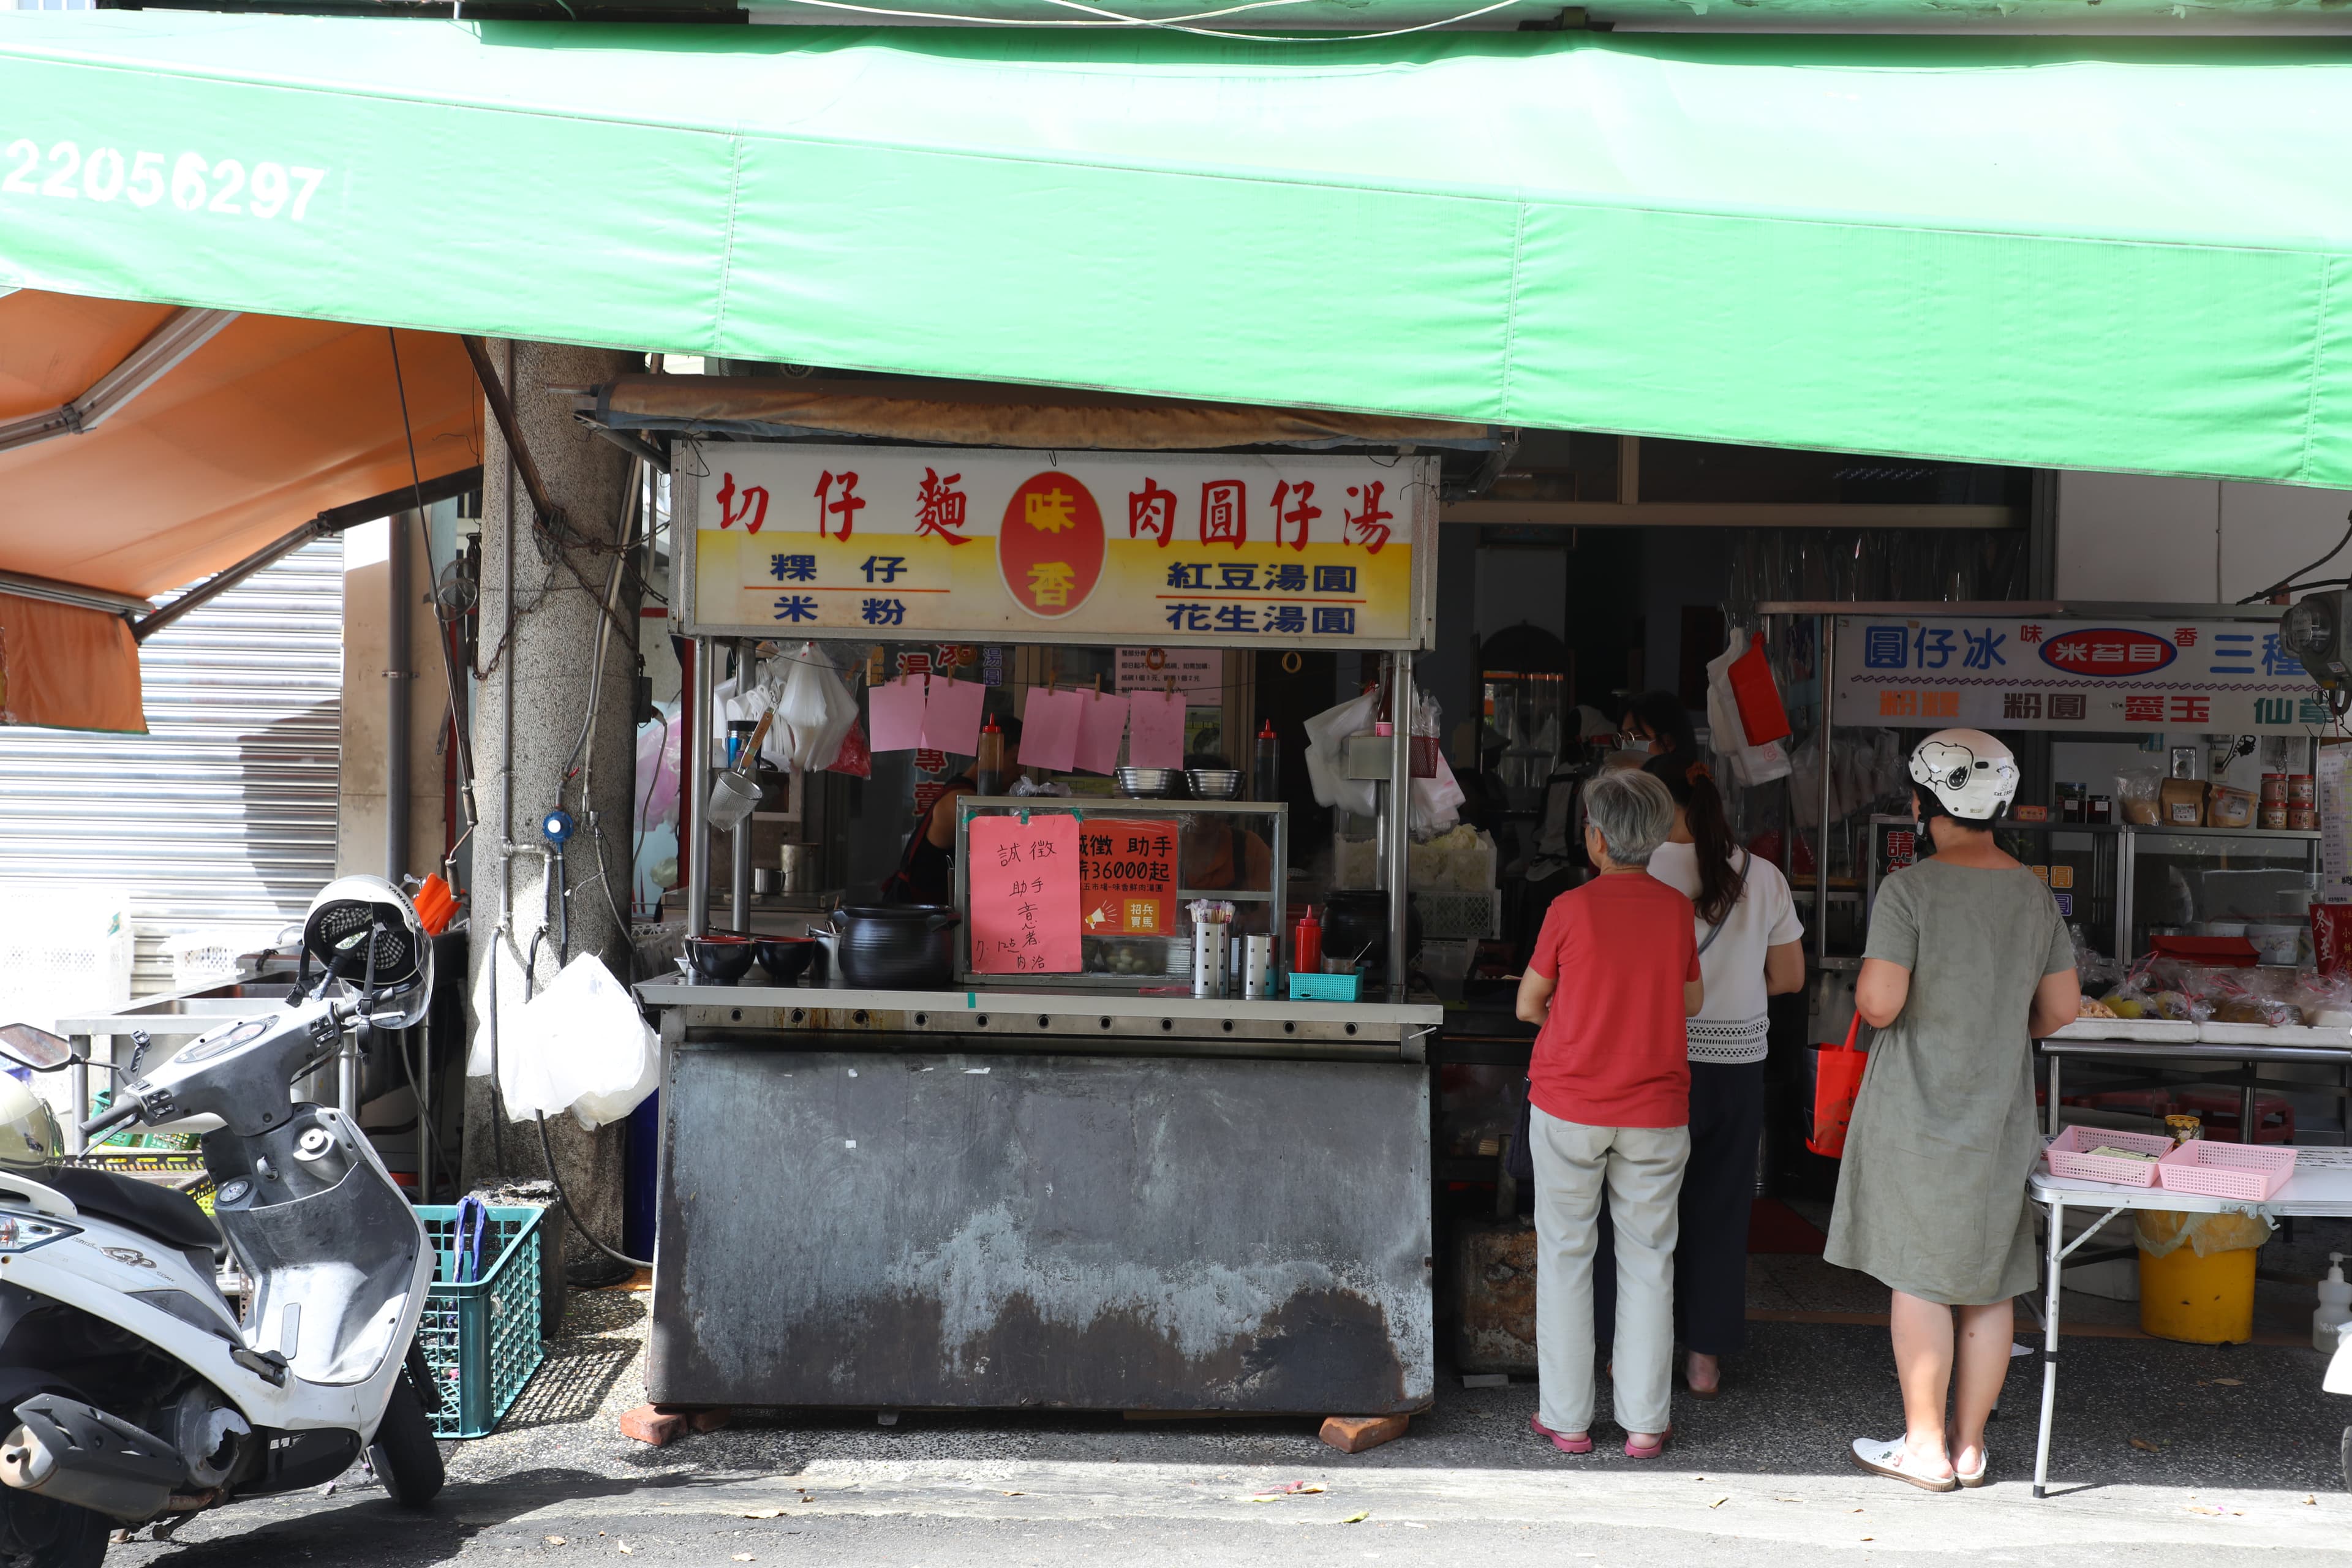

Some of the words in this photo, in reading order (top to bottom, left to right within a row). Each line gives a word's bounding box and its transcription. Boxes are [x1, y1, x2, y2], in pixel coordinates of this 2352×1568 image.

[3, 138, 327, 221] 22056297
[715, 467, 973, 546] 切仔麵
[1128, 477, 1393, 554] 肉圓仔湯
[1024, 488, 1076, 607] 味香
[770, 554, 907, 584] 粿仔
[1166, 562, 1357, 593] 紅豆湯圓
[774, 595, 907, 625] 米粉
[1166, 604, 1355, 635] 花生湯圓
[1864, 625, 2007, 669] 圓仔冰
[2020, 624, 2043, 644] 味
[2174, 627, 2199, 647] 香
[2055, 643, 2162, 663] 米苔目
[2003, 692, 2087, 719] 粉圓
[2124, 695, 2210, 723] 愛玉
[1126, 835, 1173, 858] 助手
[388, 884, 413, 915] YAMAHA
[1009, 876, 1044, 897] 助手
[1131, 903, 1153, 915] 招兵
[2313, 908, 2333, 961] 冬至
